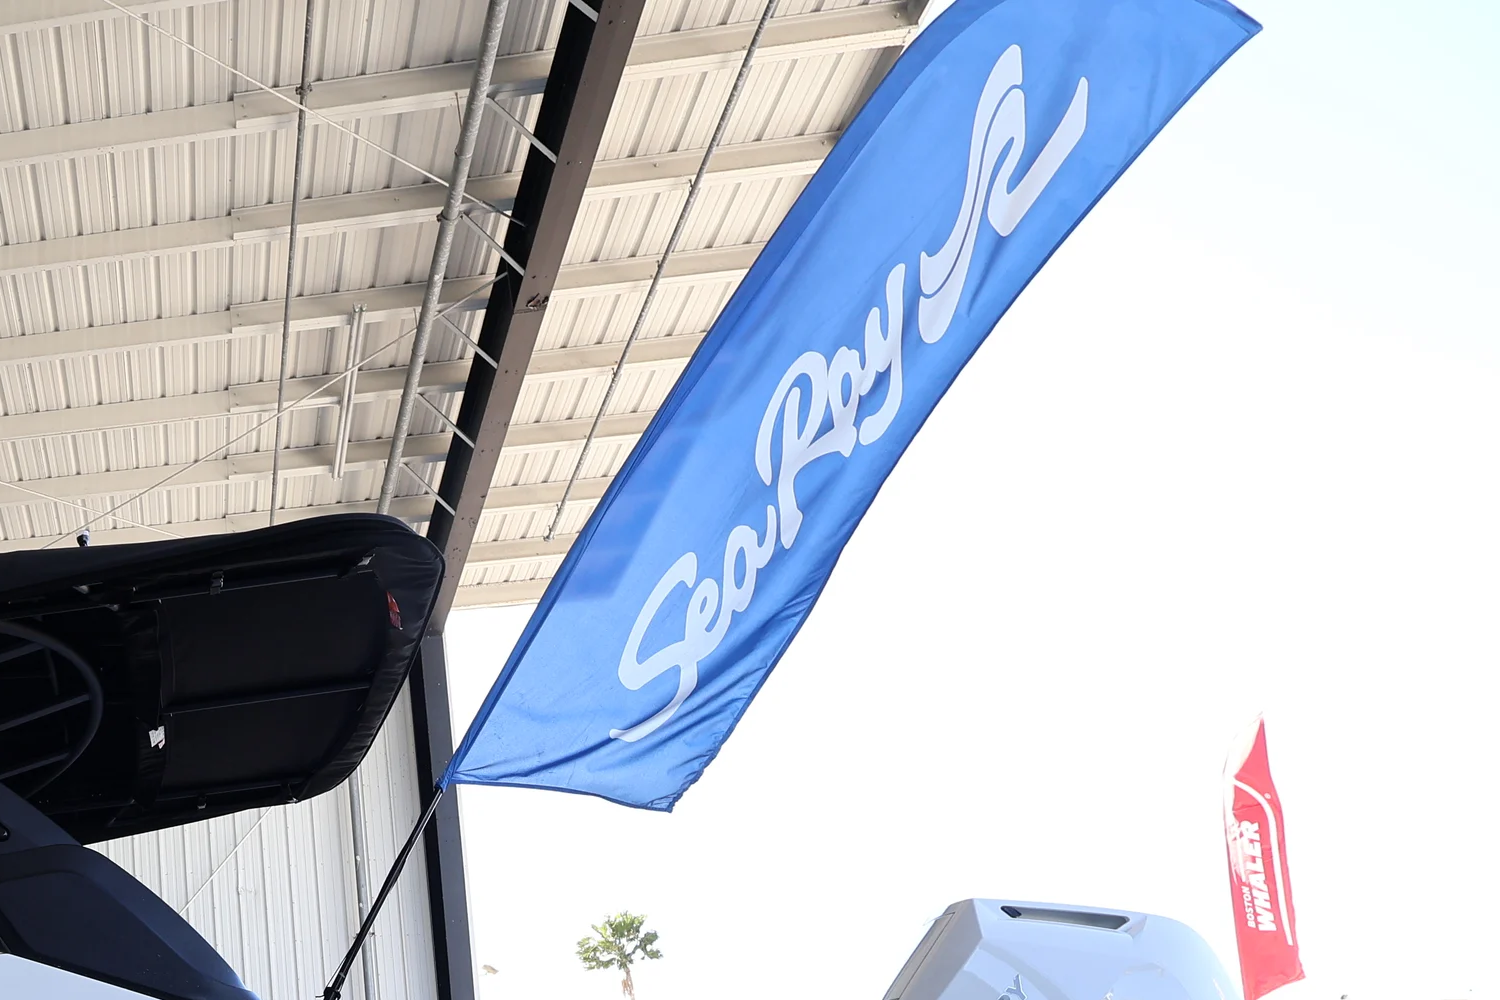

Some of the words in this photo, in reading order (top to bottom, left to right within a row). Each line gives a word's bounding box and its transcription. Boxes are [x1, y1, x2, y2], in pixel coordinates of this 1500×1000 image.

[609, 504, 777, 743] Sea
[754, 262, 906, 549] Ray
[1239, 820, 1277, 932] WHALER
[1241, 886, 1257, 928] BOSTON
